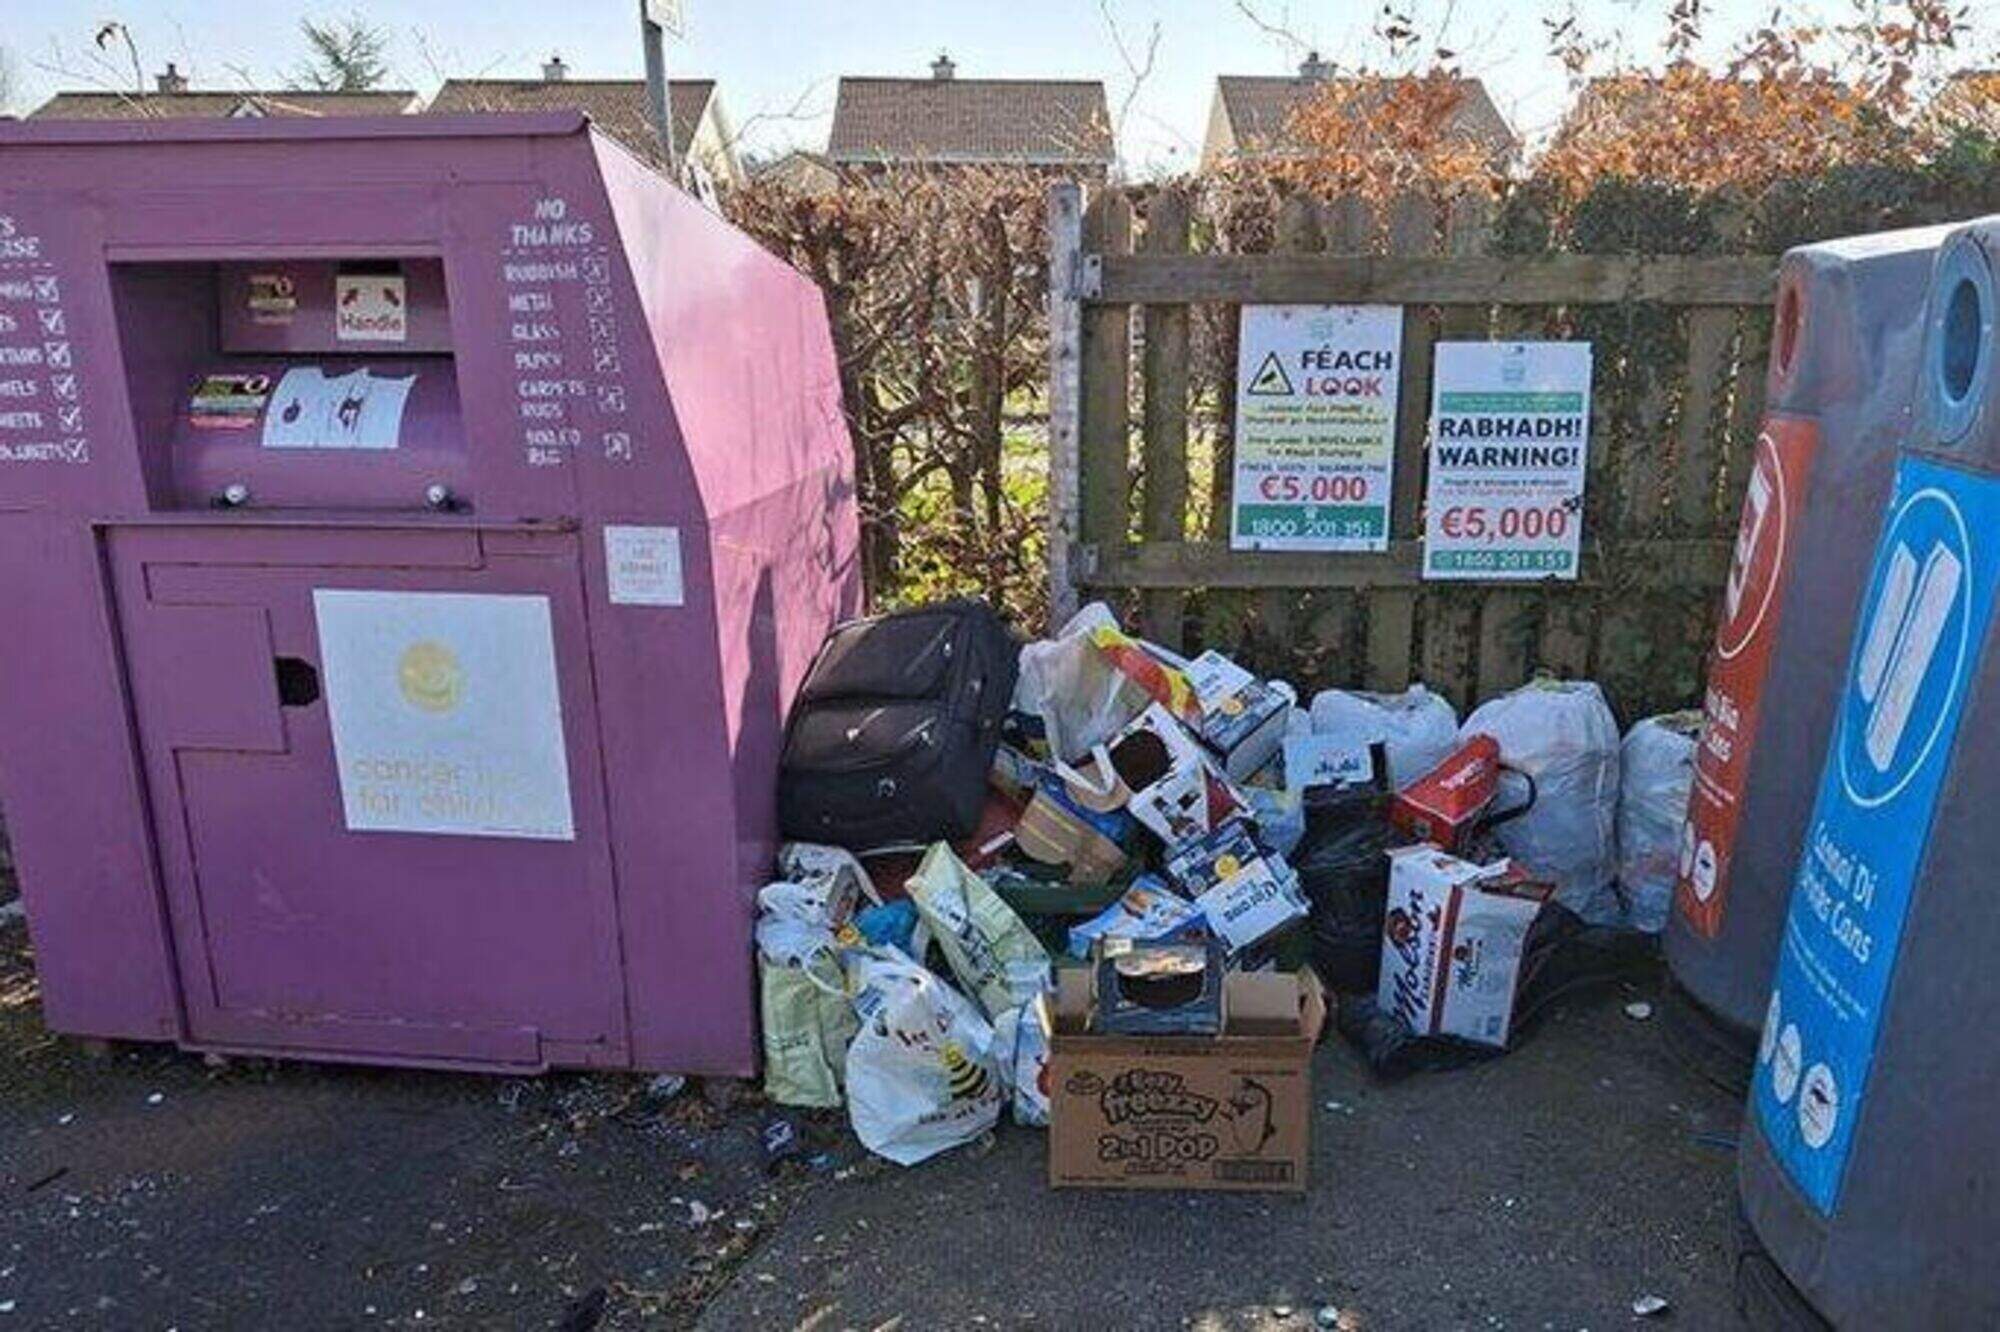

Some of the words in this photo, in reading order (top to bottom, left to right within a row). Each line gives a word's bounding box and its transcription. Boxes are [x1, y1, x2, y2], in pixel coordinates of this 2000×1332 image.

[535, 200, 566, 220] NO
[512, 224, 593, 247] THANKS
[340, 312, 402, 332] Handle
[1301, 343, 1393, 371] FÉACH
[1305, 377, 1384, 396] LOOK
[1438, 417, 1583, 438] RABHADH!
[1438, 447, 1579, 468] WARNING!
[1260, 475, 1368, 502] €5,000
[1252, 518, 1298, 536] 1800
[1303, 520, 1337, 537] 201
[1441, 506, 1568, 544] €5,000
[1499, 552, 1530, 569] 201
[1392, 887, 1428, 1041] Molson
[1156, 1133, 1219, 1160] POP
